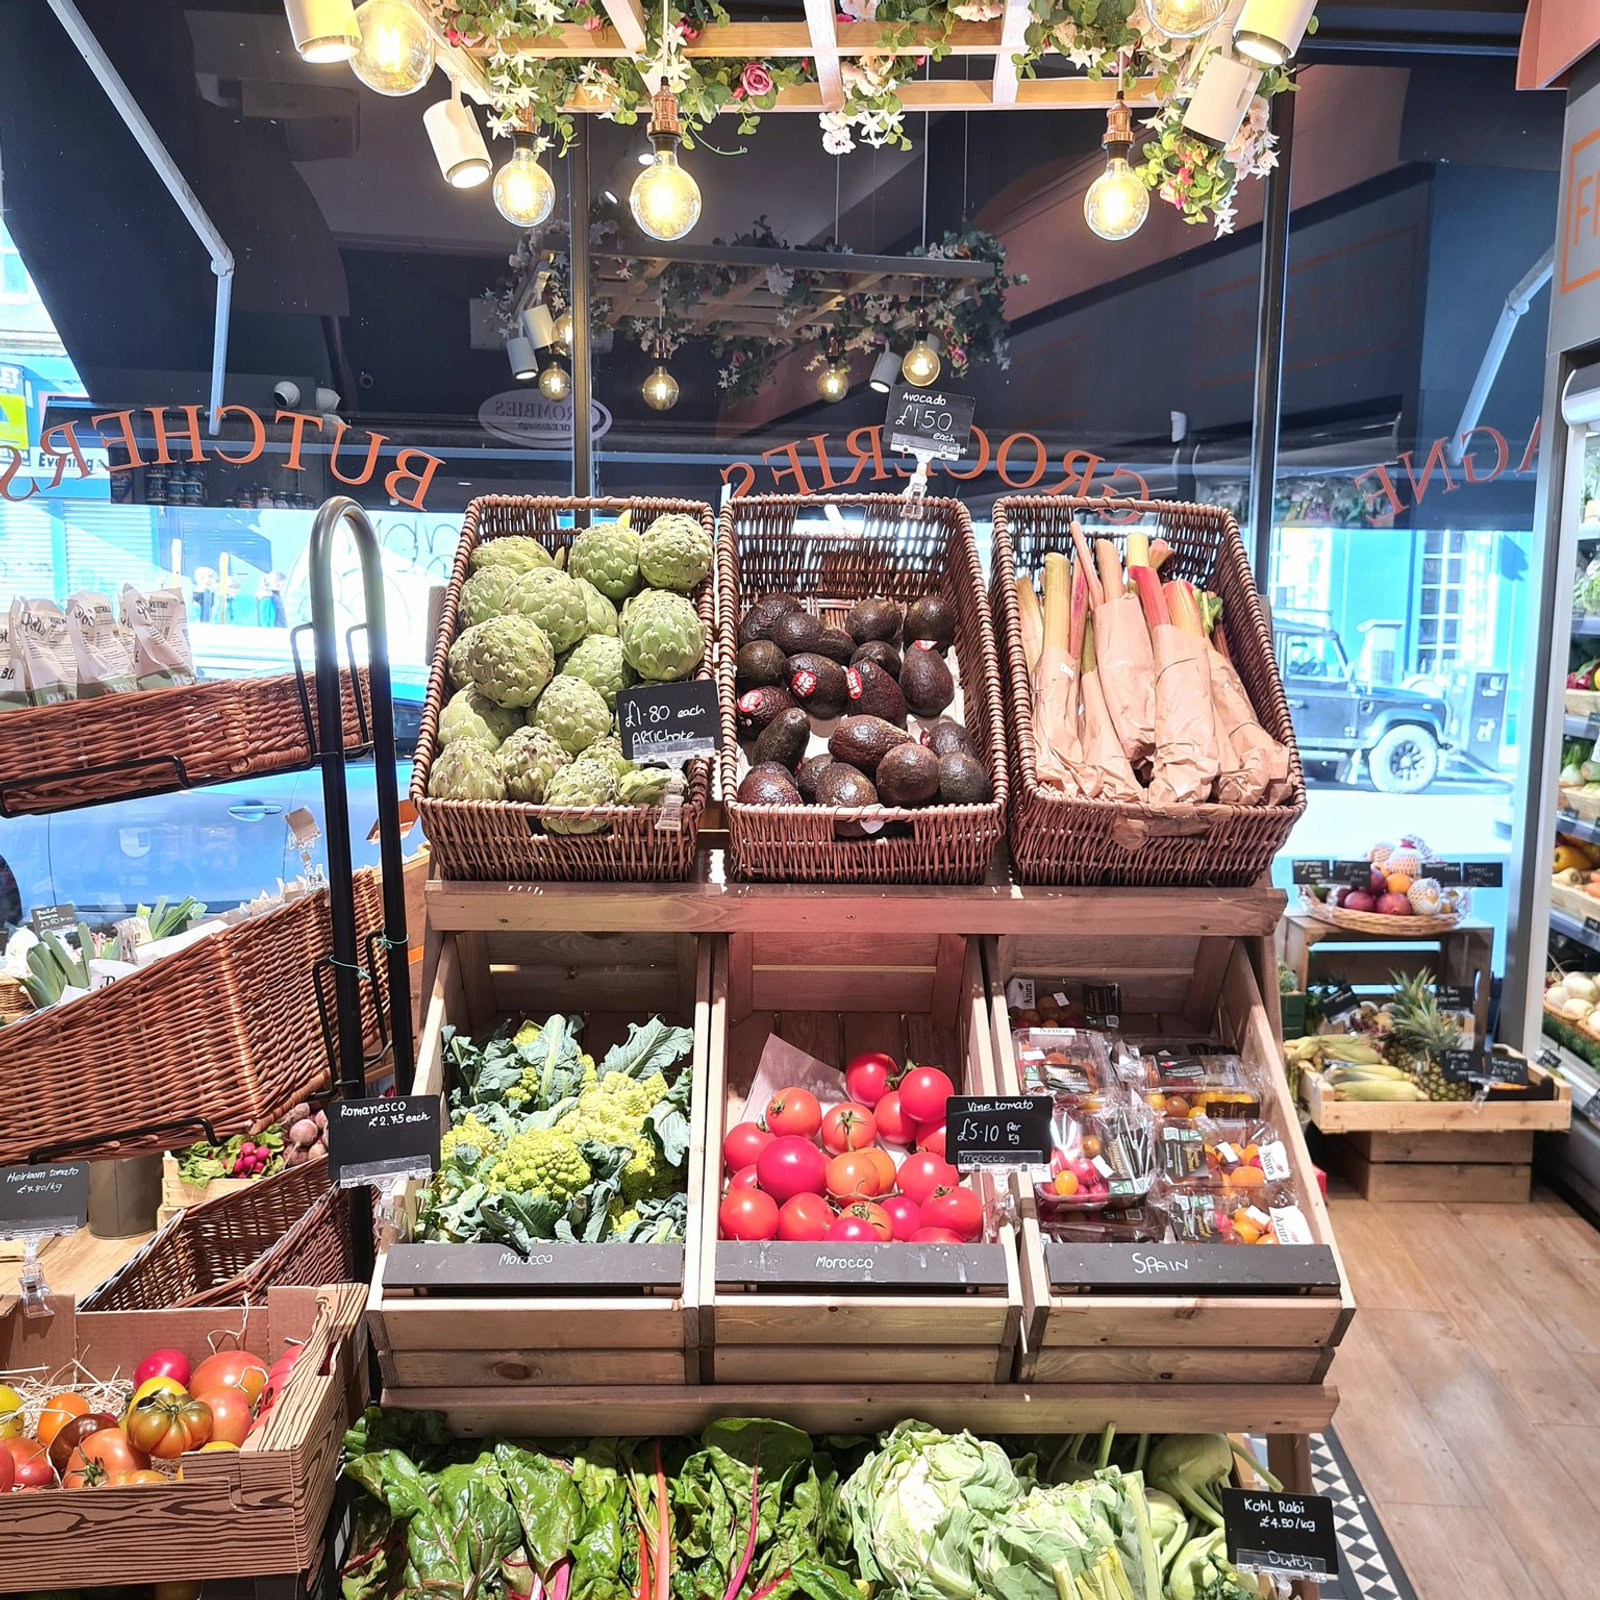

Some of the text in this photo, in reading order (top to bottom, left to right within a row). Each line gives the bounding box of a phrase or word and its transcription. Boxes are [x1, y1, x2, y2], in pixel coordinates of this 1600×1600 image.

[902, 391, 947, 406] Avocado
[933, 432, 955, 443] each
[677, 704, 706, 718] each
[340, 1101, 406, 1117] Romanesco
[967, 1099, 1033, 1112] Vine tomato
[368, 1112, 431, 1129] £2.75 each
[1262, 1150, 1276, 1176] Azura
[7, 1167, 79, 1183] Heirloom tomato
[1274, 1215, 1290, 1243] Azura
[815, 1255, 874, 1269] Morocco
[1243, 1498, 1305, 1513] Kohl Rabi
[1259, 1516, 1316, 1532] £4.50/kg
